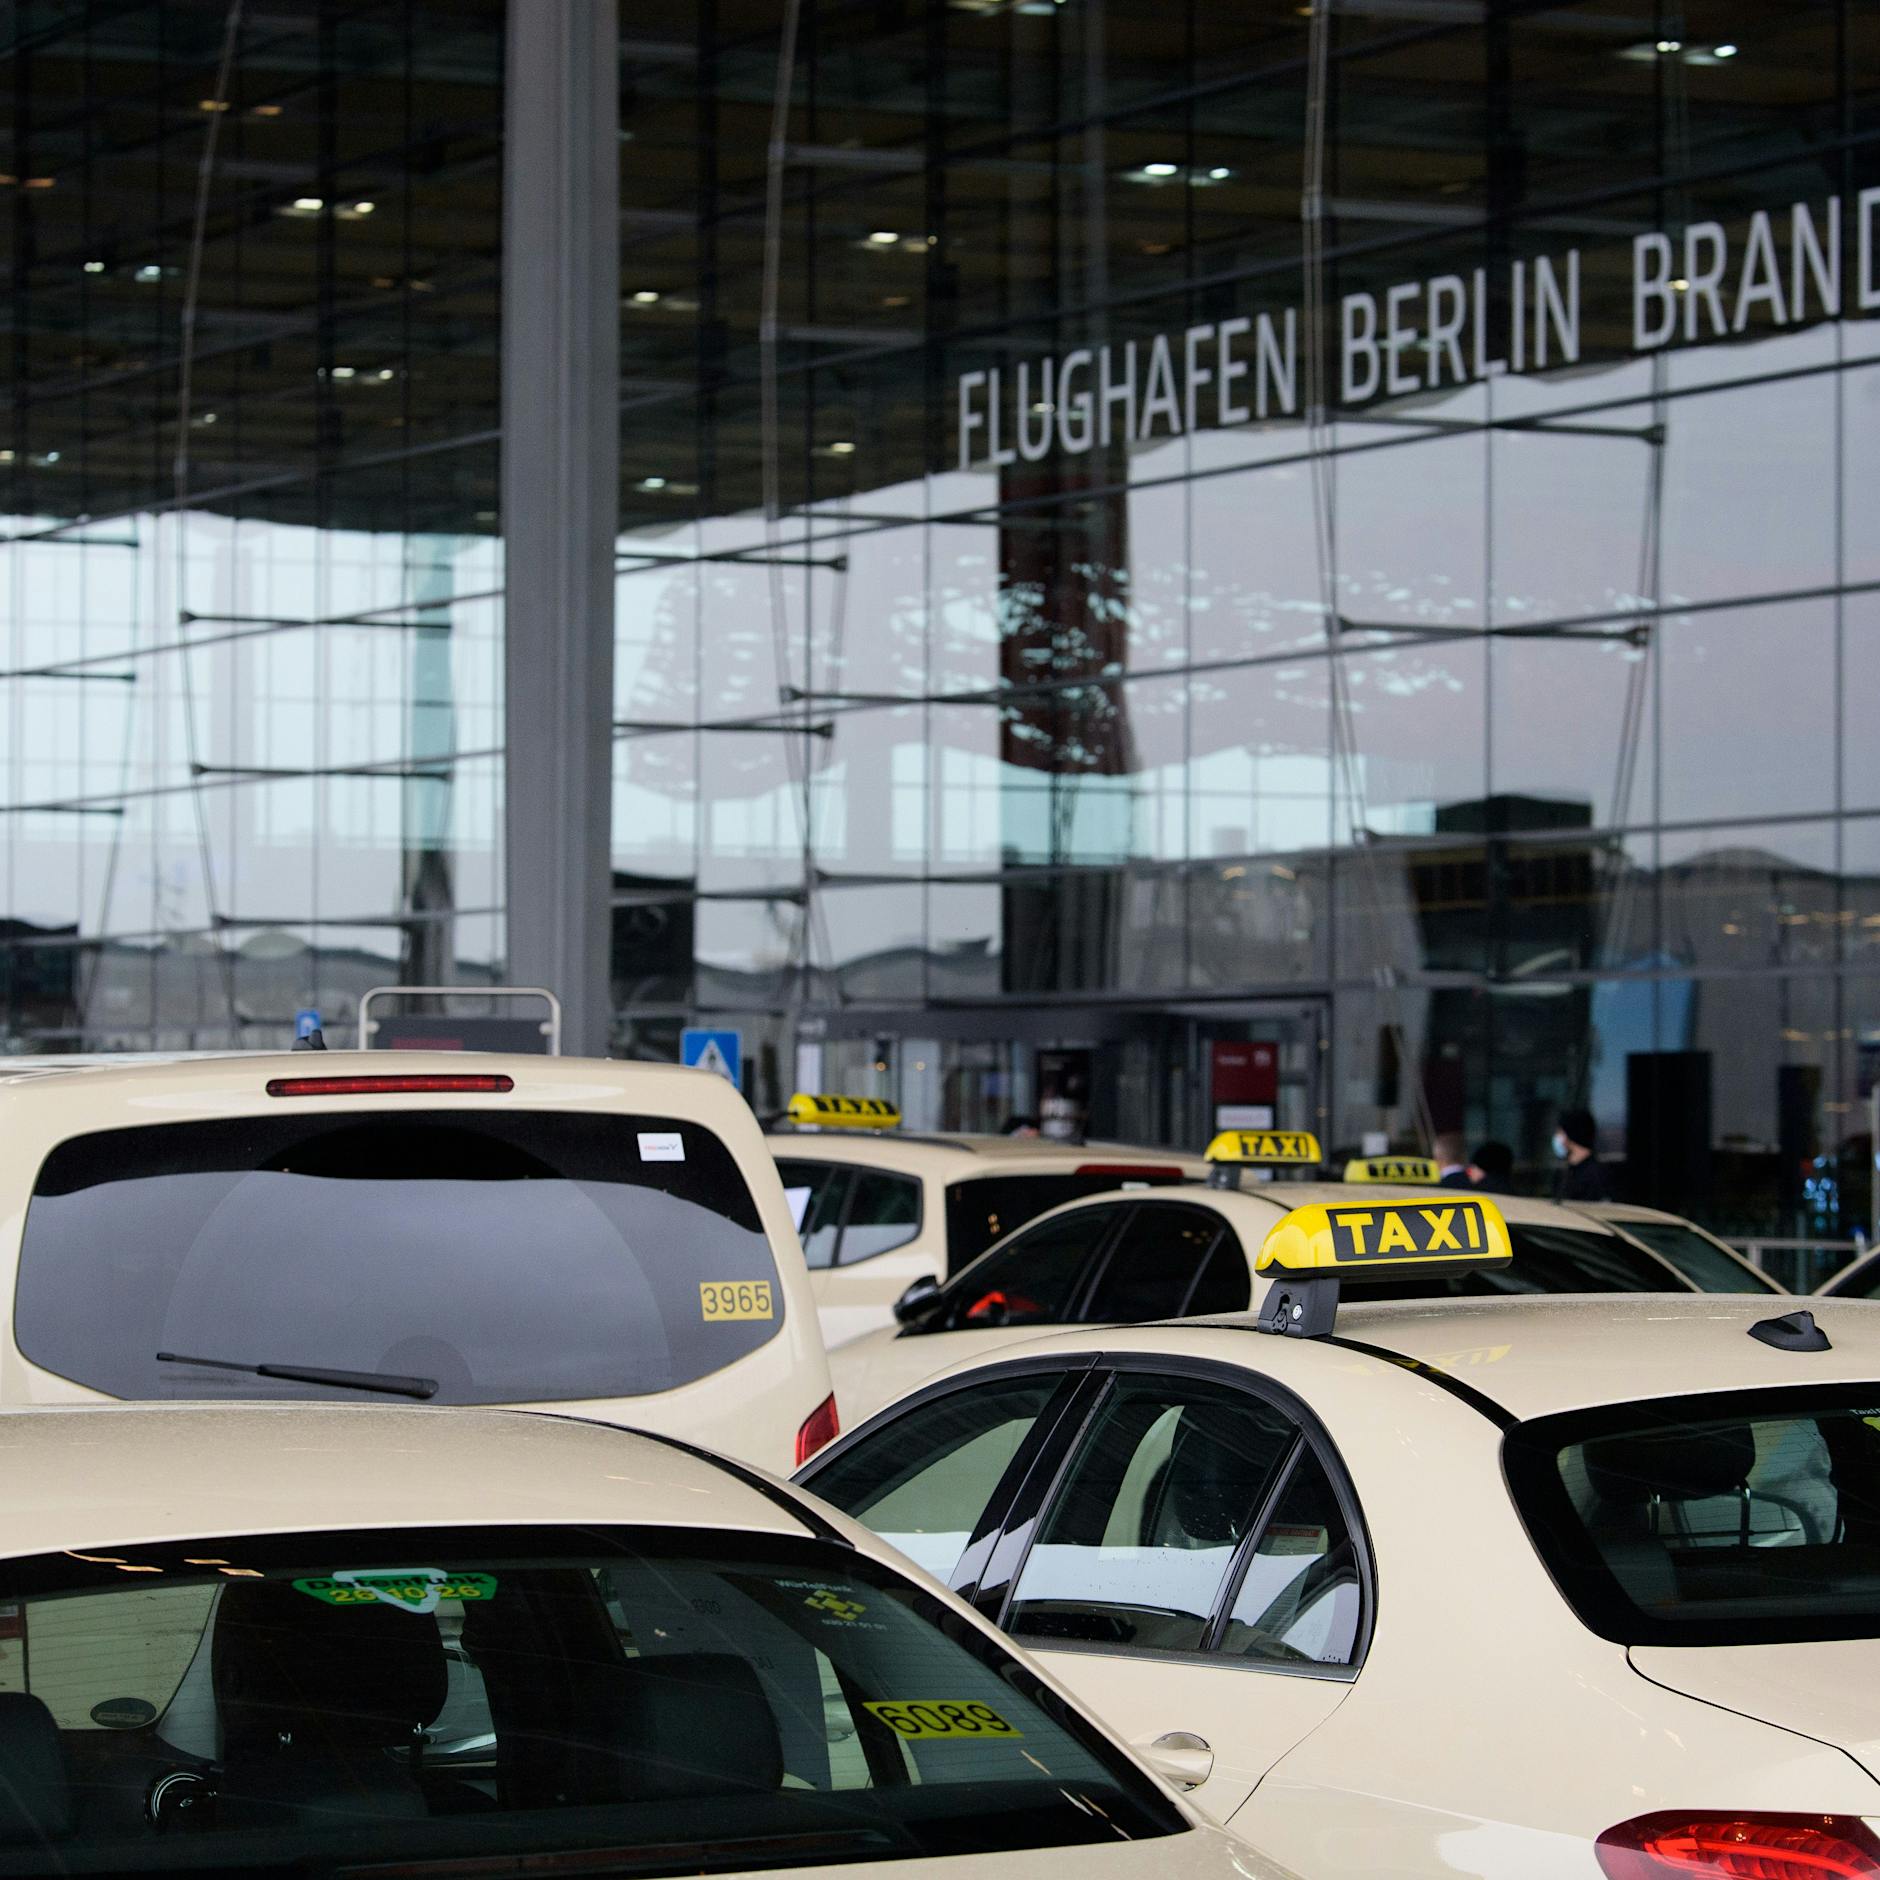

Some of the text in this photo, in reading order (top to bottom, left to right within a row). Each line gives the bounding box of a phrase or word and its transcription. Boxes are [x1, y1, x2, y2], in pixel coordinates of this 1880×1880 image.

[958, 308, 1298, 469] FLUGHAFEN
[1341, 249, 1581, 404] BERLIN
[1243, 1136, 1308, 1157] TAXI
[1374, 1163, 1427, 1177] TAXI
[1335, 1207, 1482, 1255] TAXI
[702, 1283, 770, 1314] 3965
[329, 1588, 376, 1603] 26
[437, 1585, 482, 1598] 26
[876, 1704, 1012, 1734] 6089
